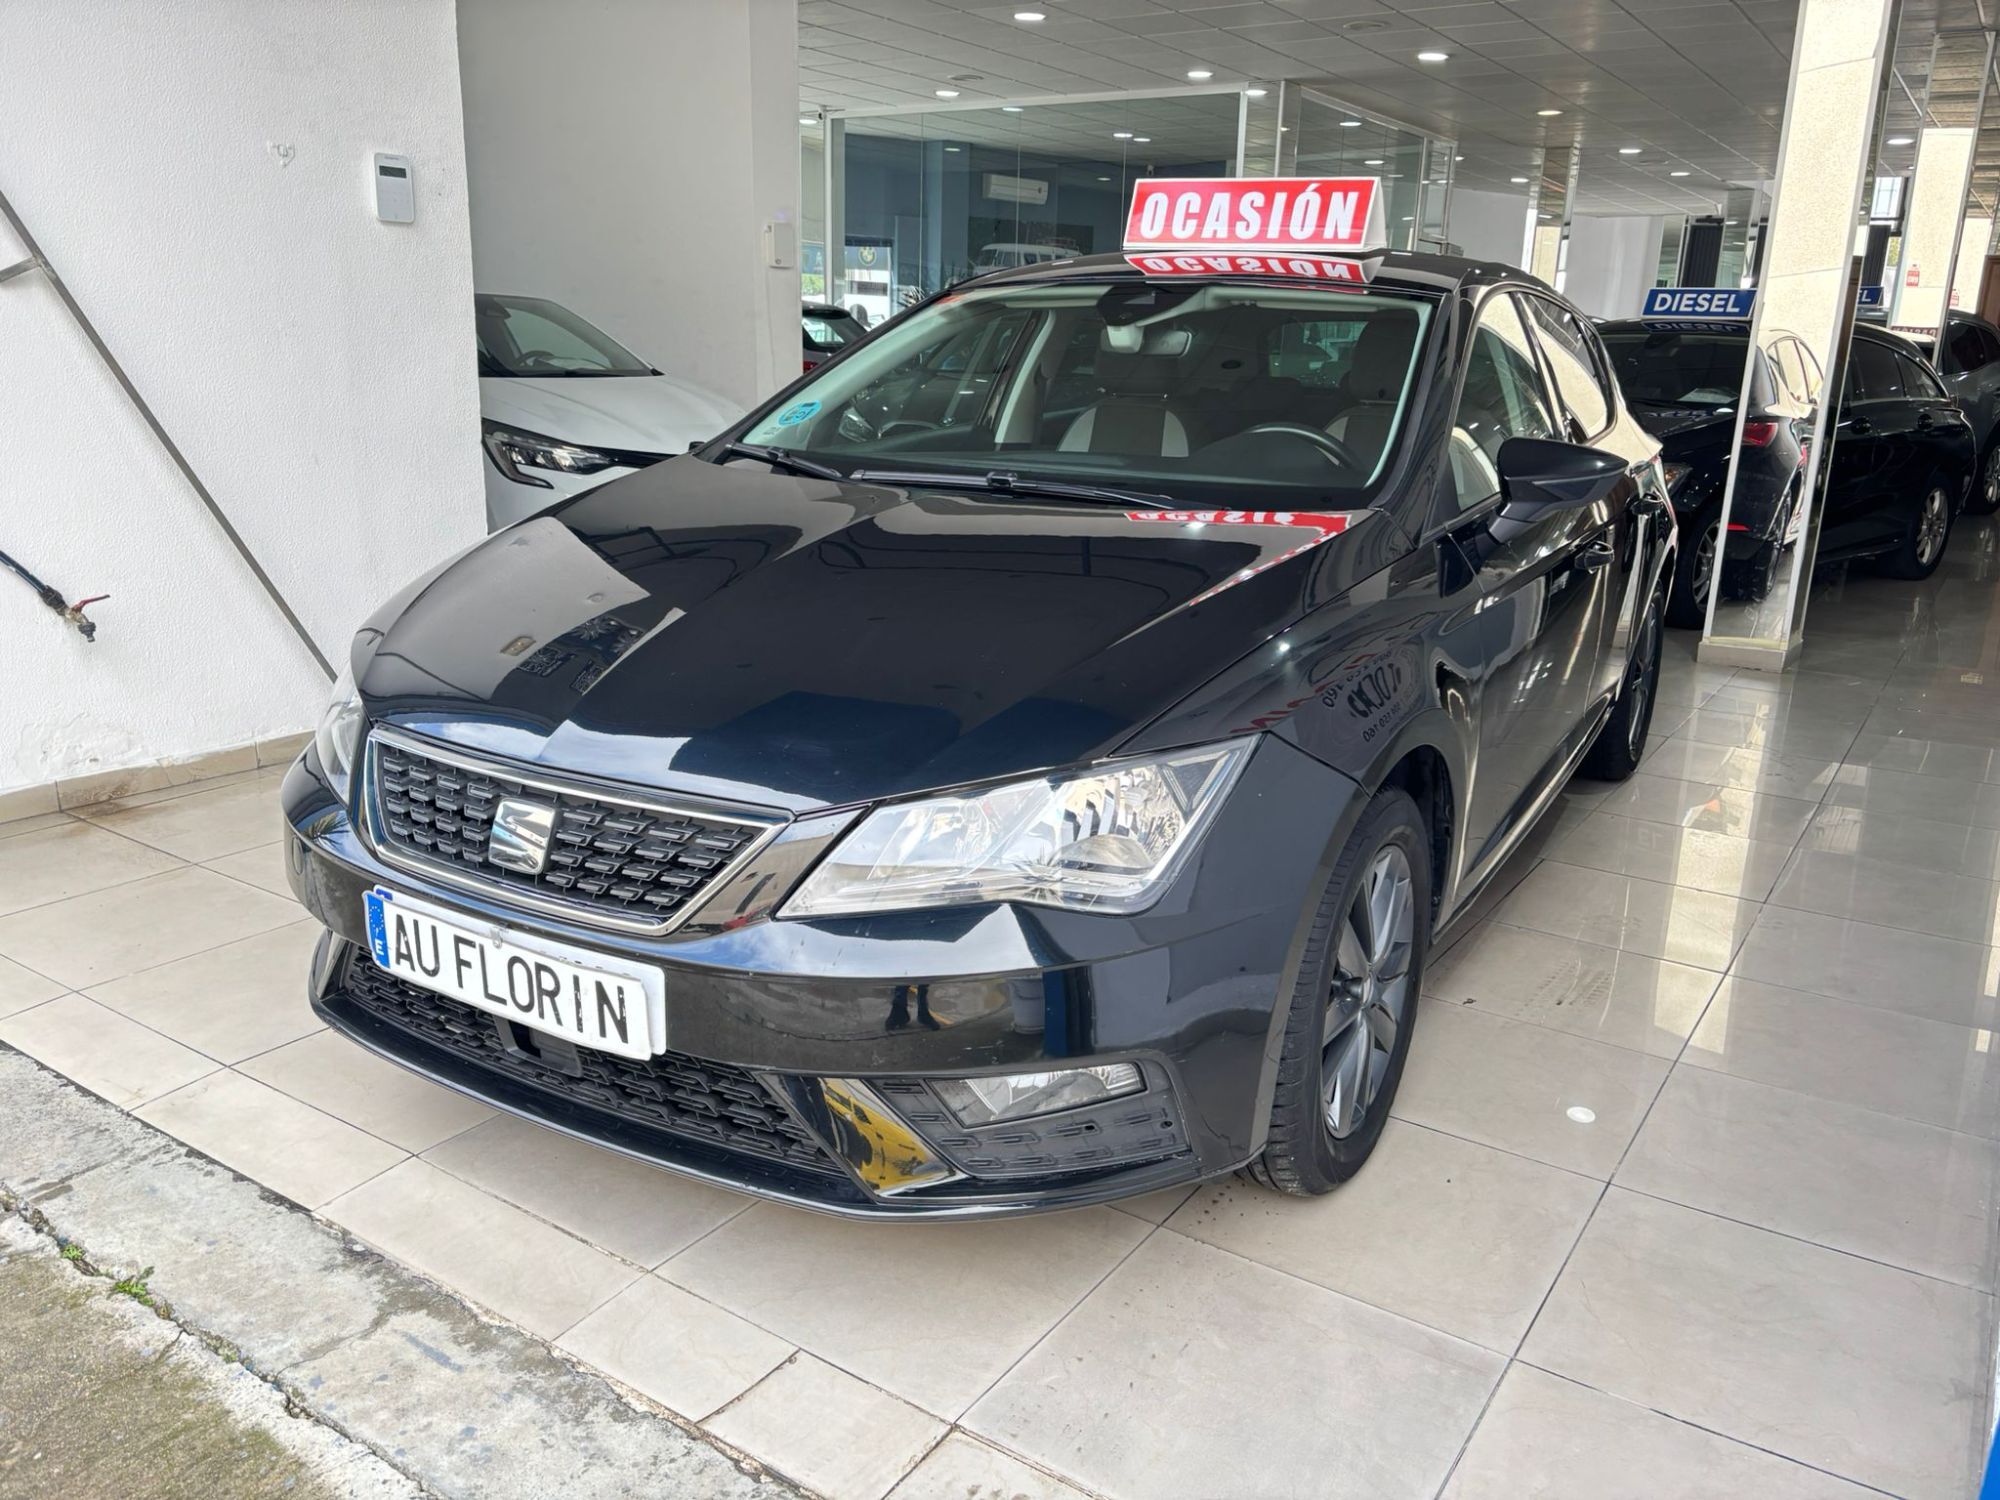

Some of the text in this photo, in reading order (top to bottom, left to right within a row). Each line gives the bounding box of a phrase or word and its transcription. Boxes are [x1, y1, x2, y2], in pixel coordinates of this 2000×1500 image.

[1140, 183, 1358, 239] OCASIÓN
[1653, 293, 1740, 313] DIESEL
[374, 938, 385, 956] E
[395, 914, 629, 1044] AU FLORIN
